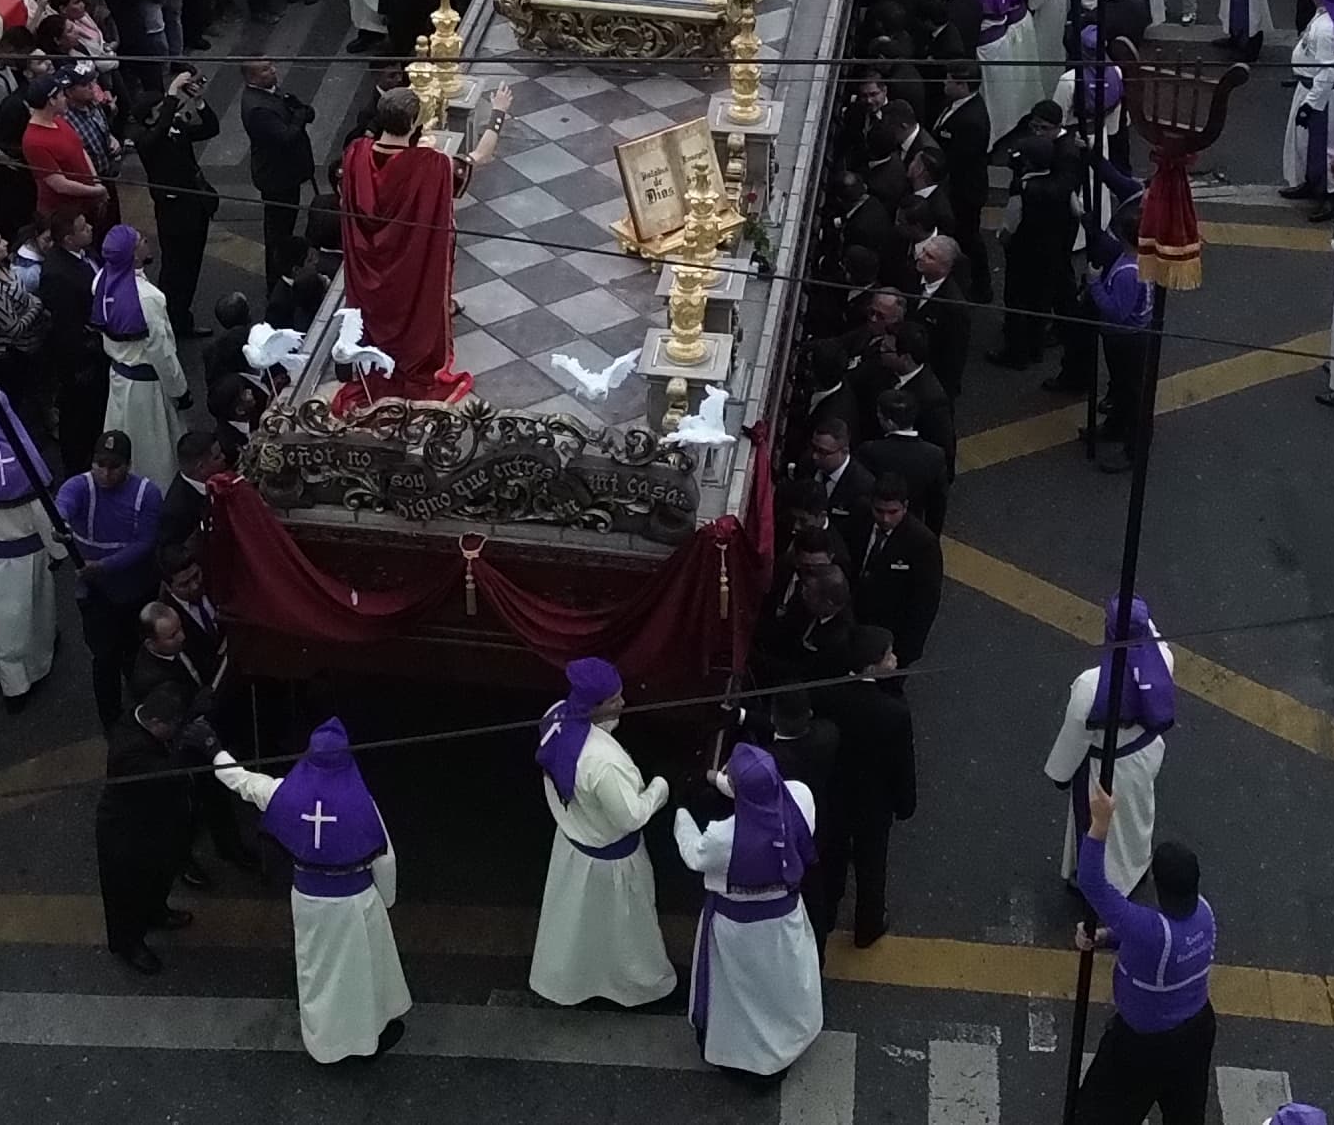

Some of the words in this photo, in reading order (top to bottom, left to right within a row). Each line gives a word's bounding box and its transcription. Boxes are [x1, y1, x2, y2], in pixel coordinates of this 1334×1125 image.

[645, 186, 675, 205] Dios
[347, 449, 372, 467] no
[390, 473, 427, 494] soy
[451, 469, 490, 500] que
[493, 455, 556, 481] entres
[586, 472, 620, 494] mi
